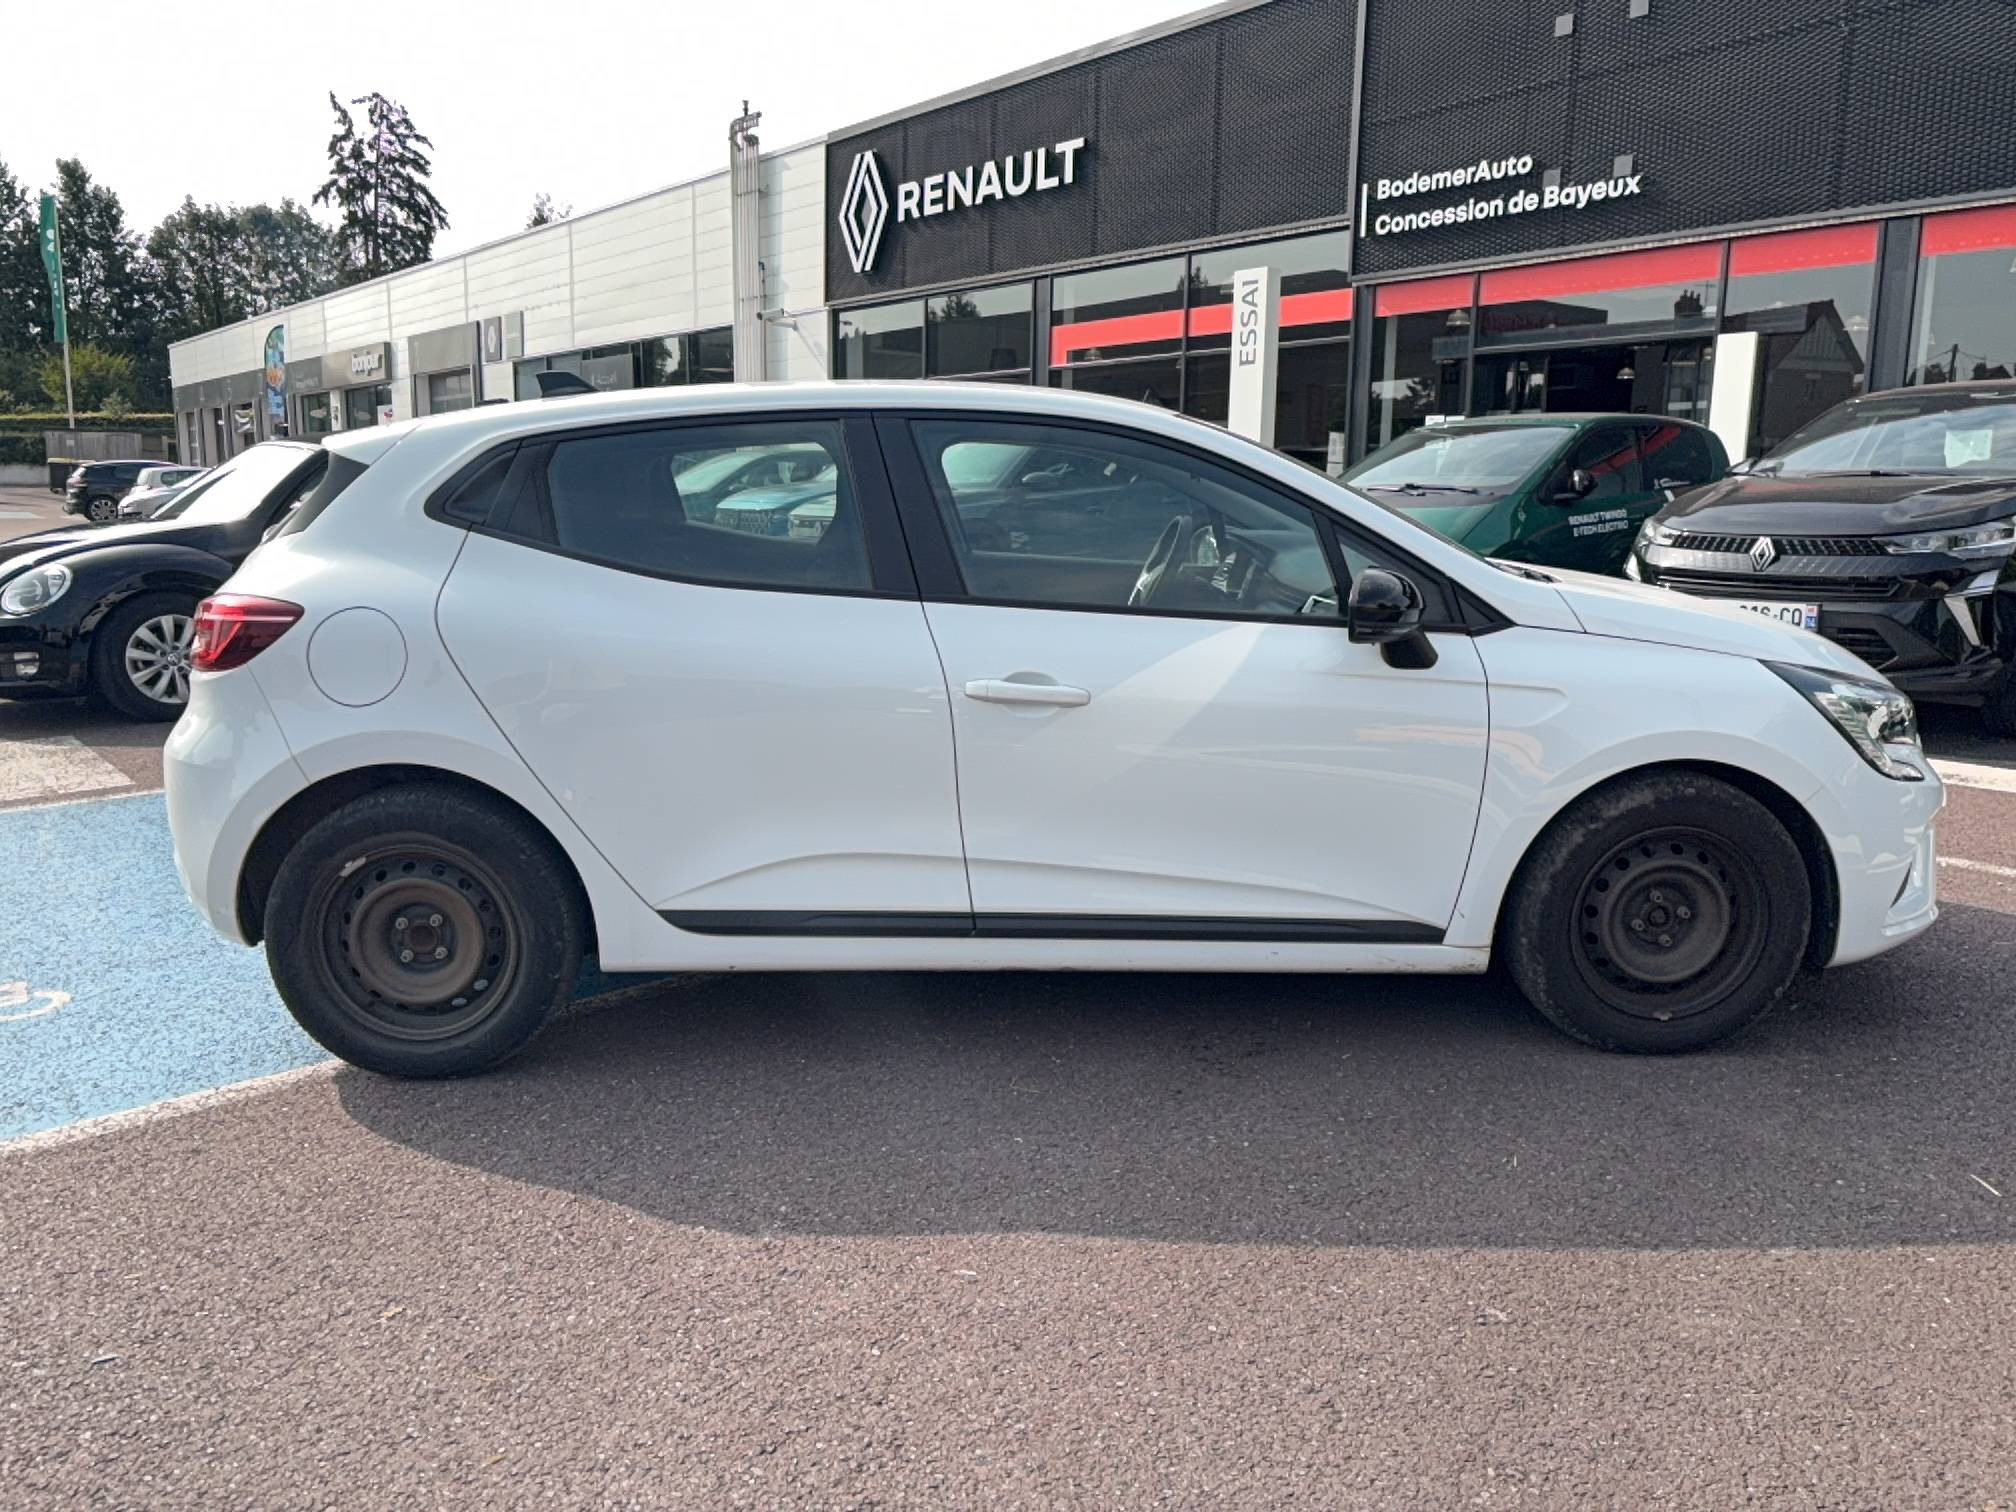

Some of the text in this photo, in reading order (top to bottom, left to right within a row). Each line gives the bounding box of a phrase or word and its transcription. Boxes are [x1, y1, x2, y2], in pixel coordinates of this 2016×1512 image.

[897, 137, 1086, 223] RENAULT
[1374, 174, 1642, 236] Concession de Bayeux
[1376, 153, 1534, 200] BodemerAuto
[1239, 279, 1259, 367] ESSAI
